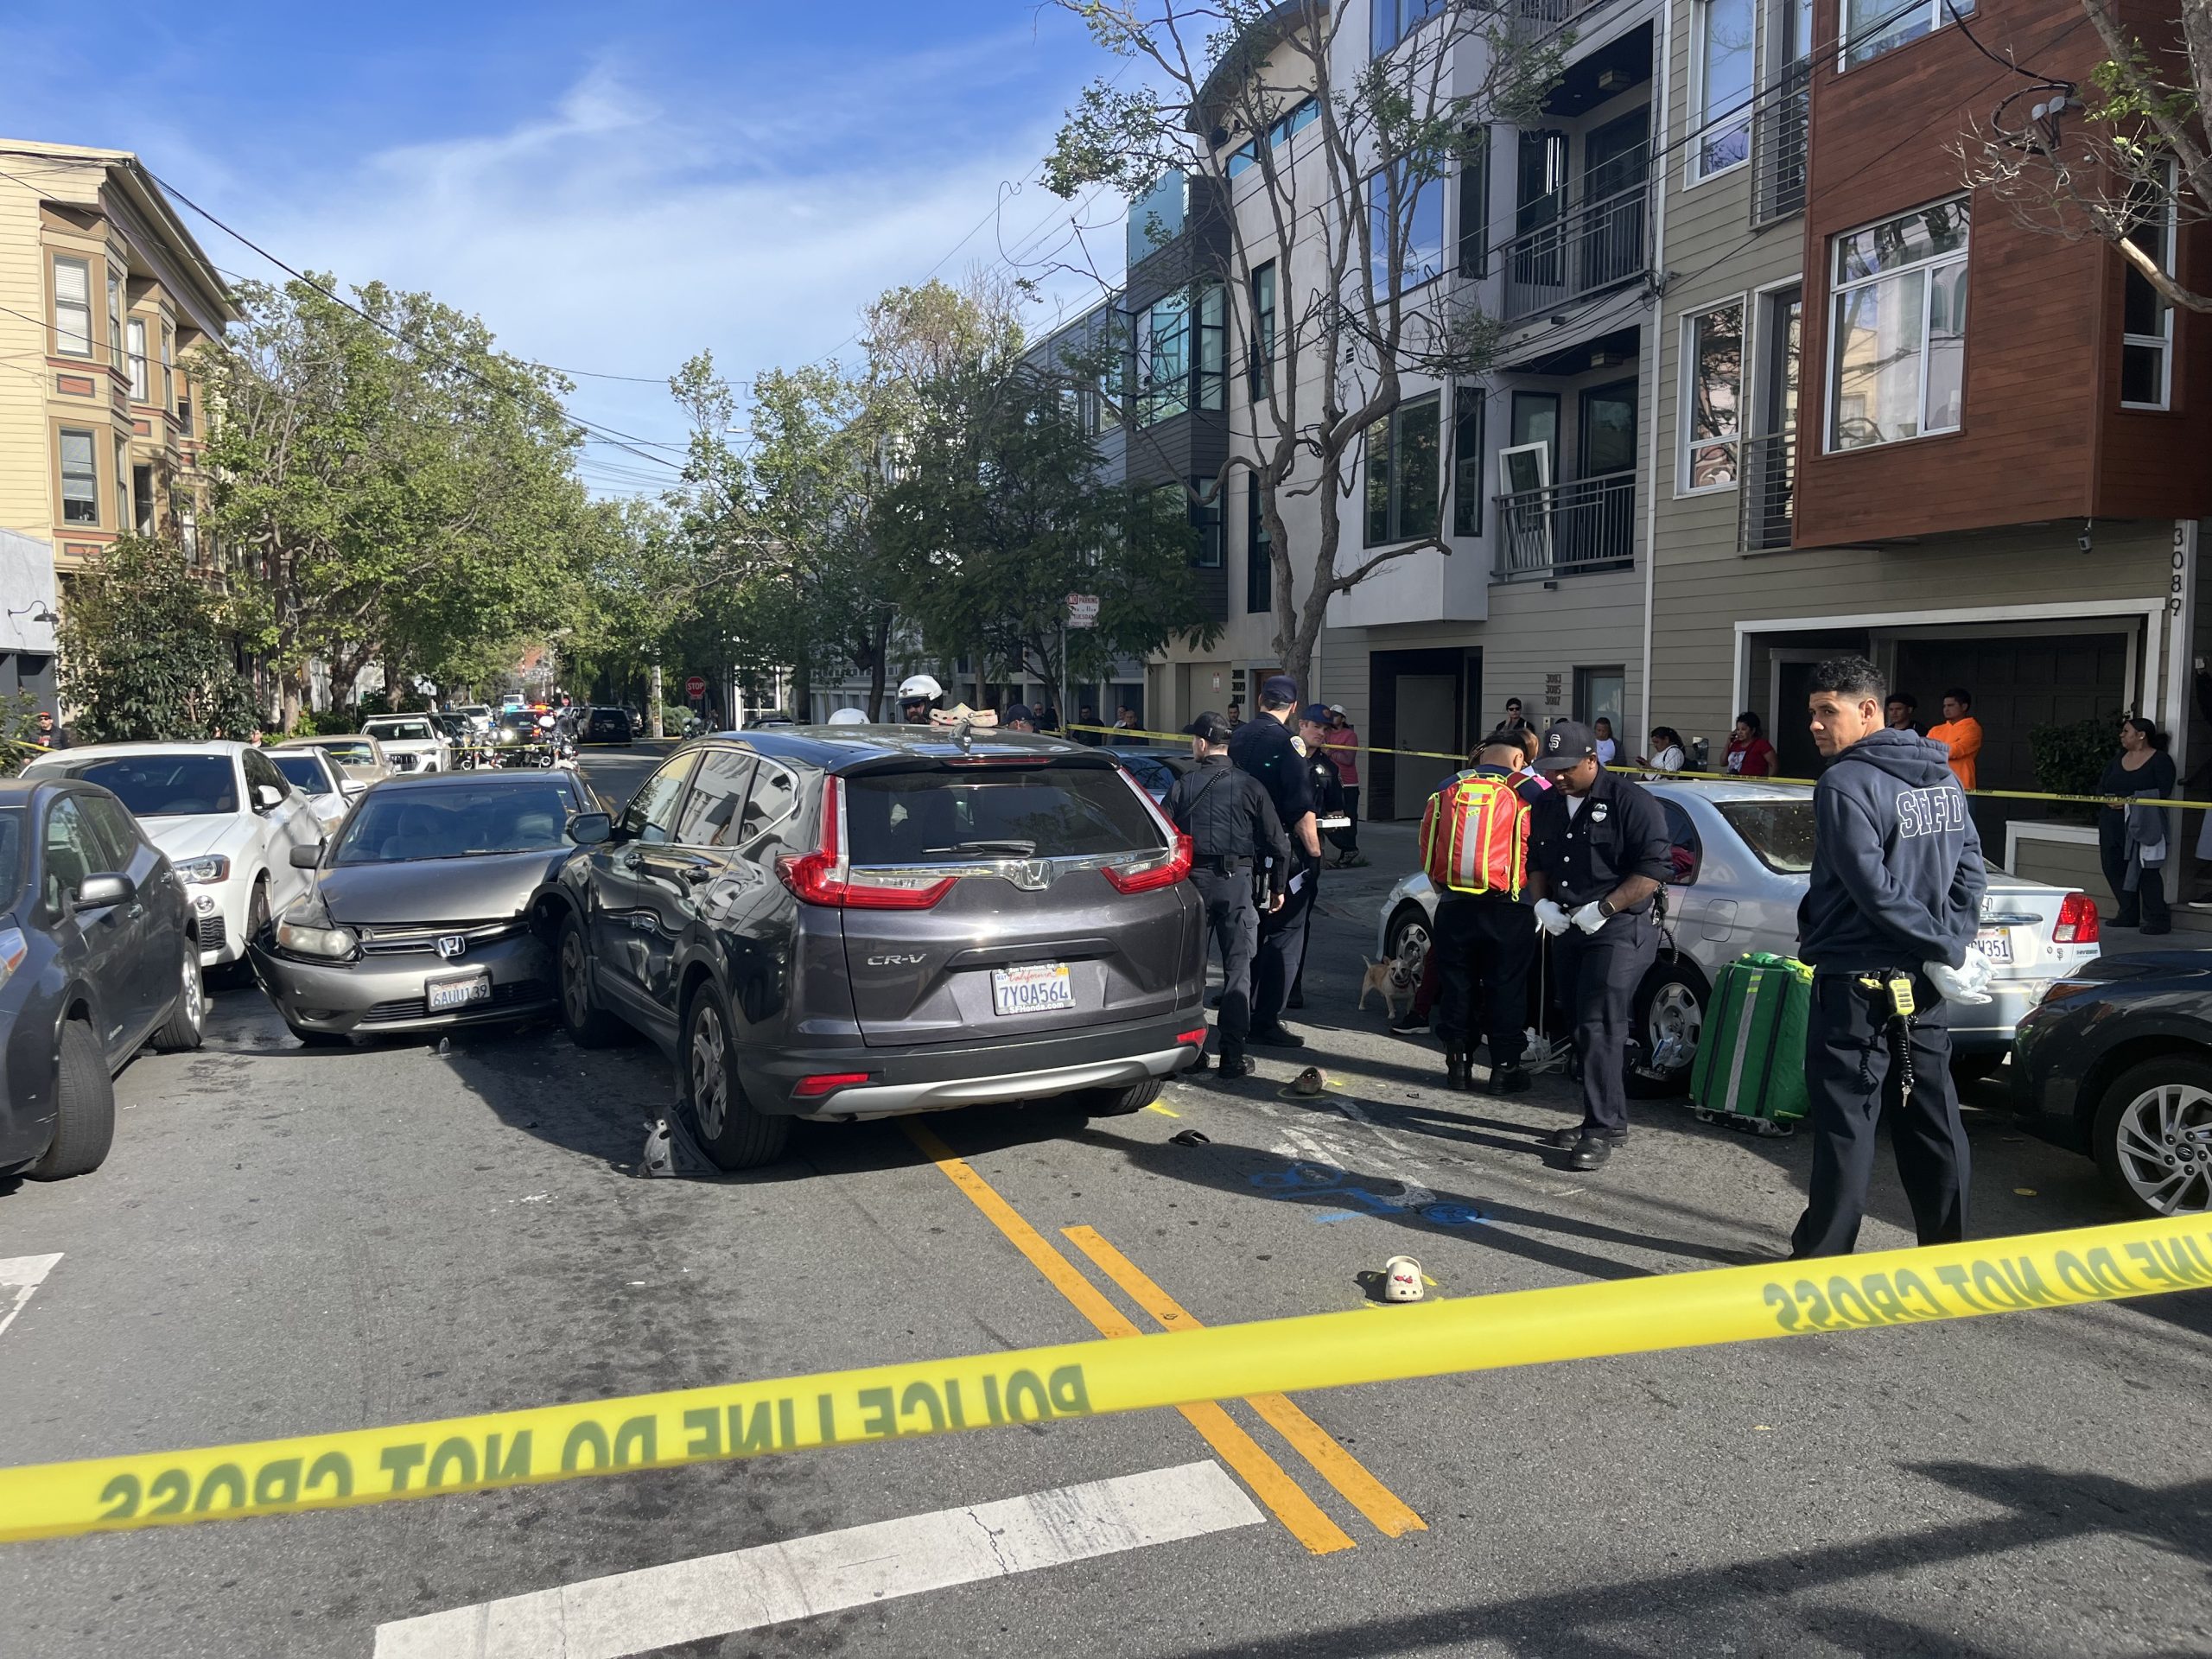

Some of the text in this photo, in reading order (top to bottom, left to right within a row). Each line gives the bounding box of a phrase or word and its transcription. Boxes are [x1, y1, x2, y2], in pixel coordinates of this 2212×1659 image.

[2170, 527, 2183, 617] 3089
[867, 953, 927, 966] CR-V
[1009, 1002, 1065, 1014] SFHonda.com
